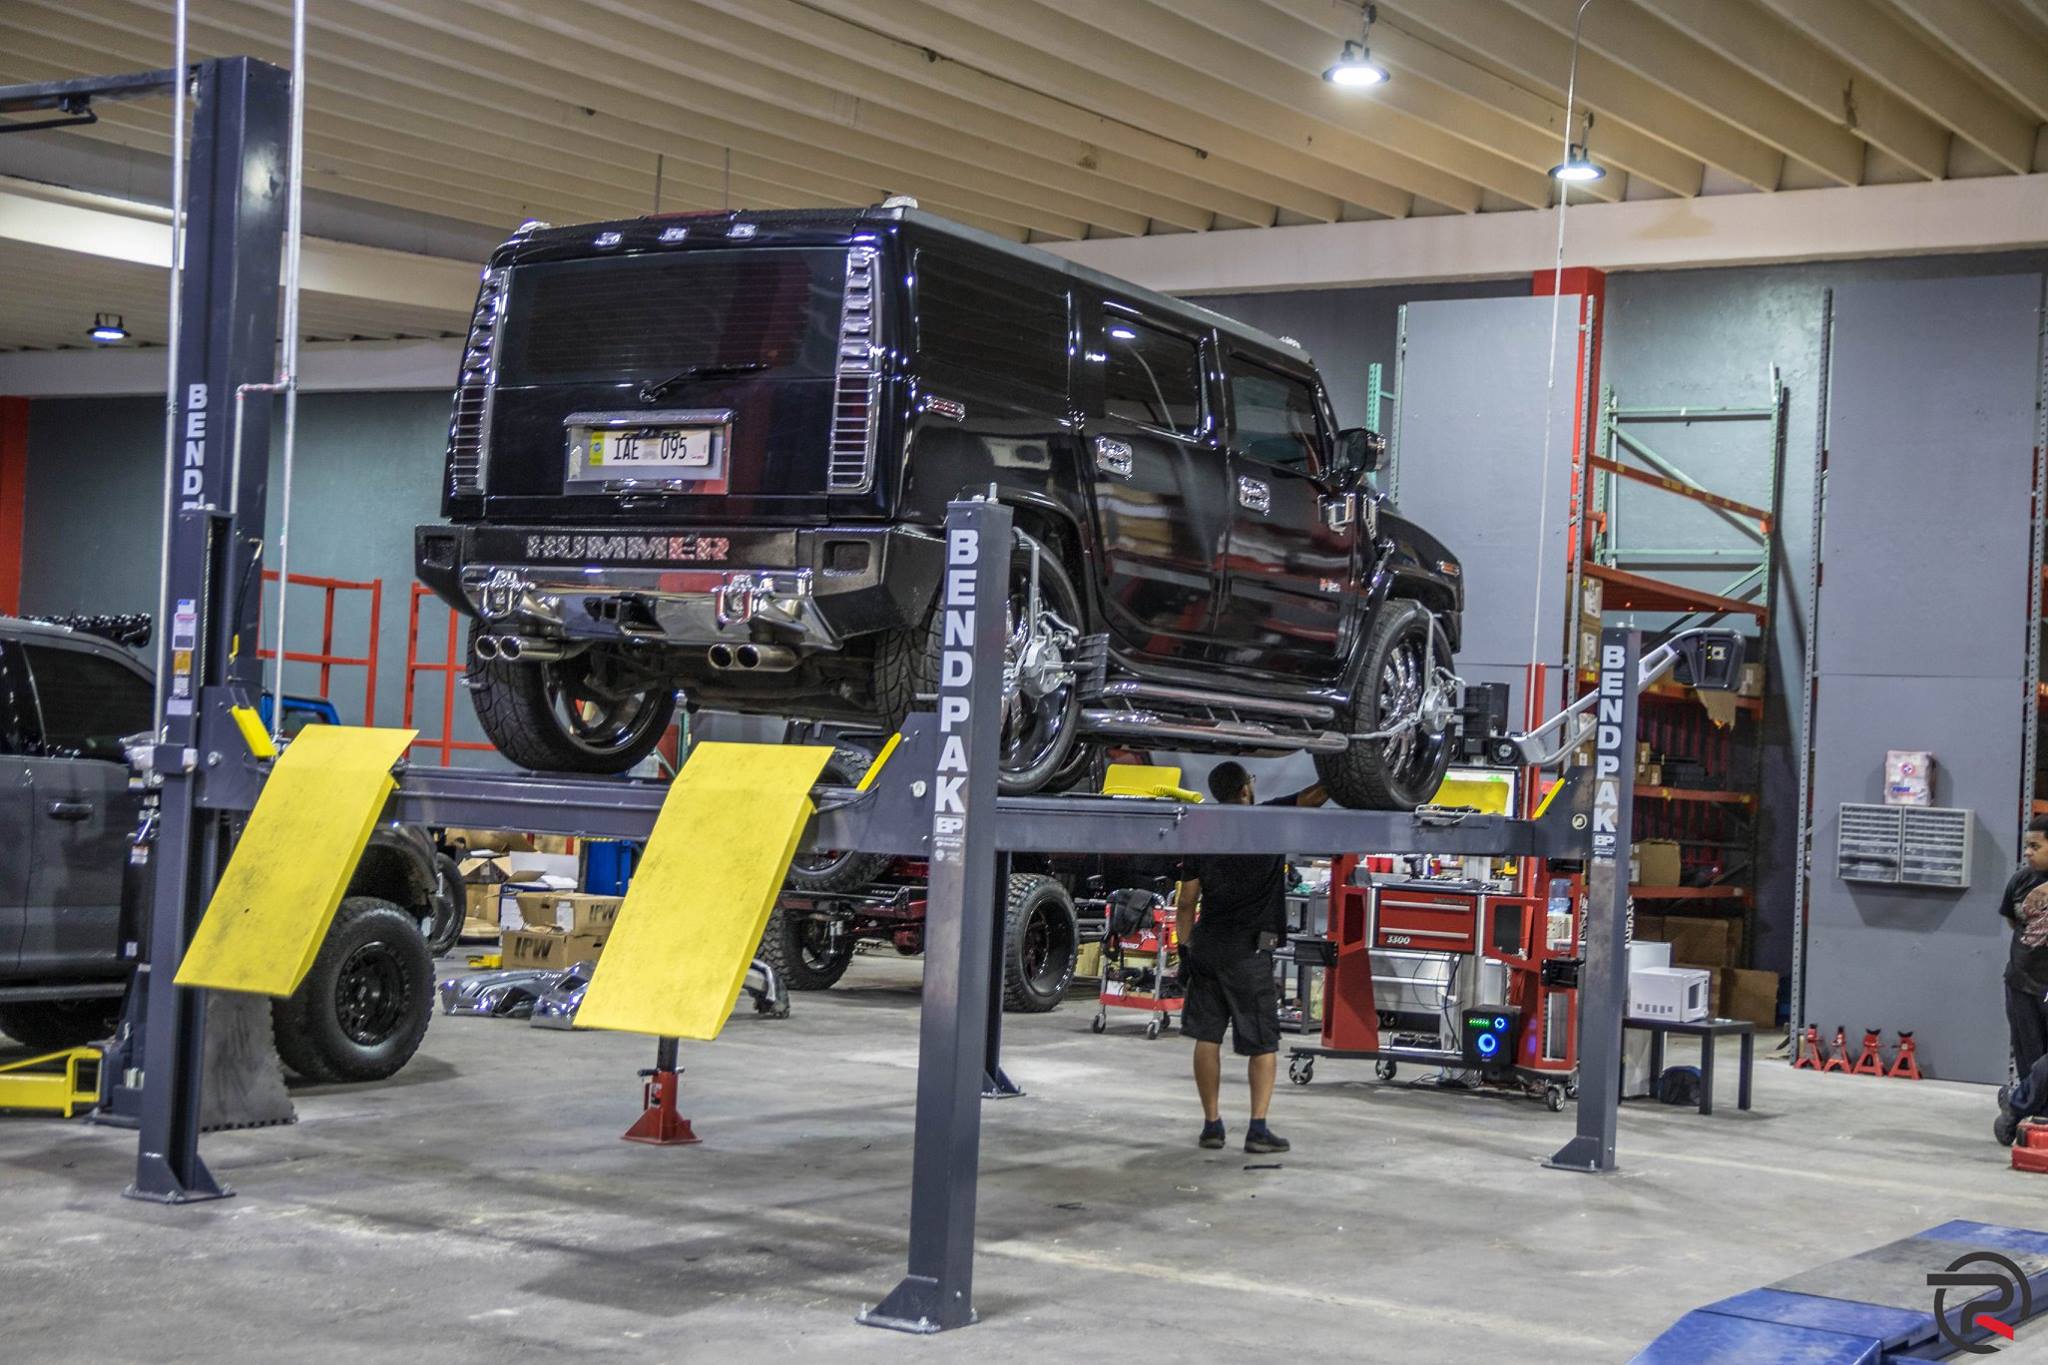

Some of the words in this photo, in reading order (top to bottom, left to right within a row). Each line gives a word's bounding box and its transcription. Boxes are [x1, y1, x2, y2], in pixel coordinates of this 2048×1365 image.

[182, 383, 208, 510] BEND
[613, 437, 640, 460] IAE
[660, 436, 687, 460] 095
[526, 535, 730, 561] HUMMER
[934, 529, 979, 813] BENDPAK
[1592, 645, 1625, 832] BENDPAK
[936, 817, 964, 834] BP
[513, 936, 553, 959] IPW
